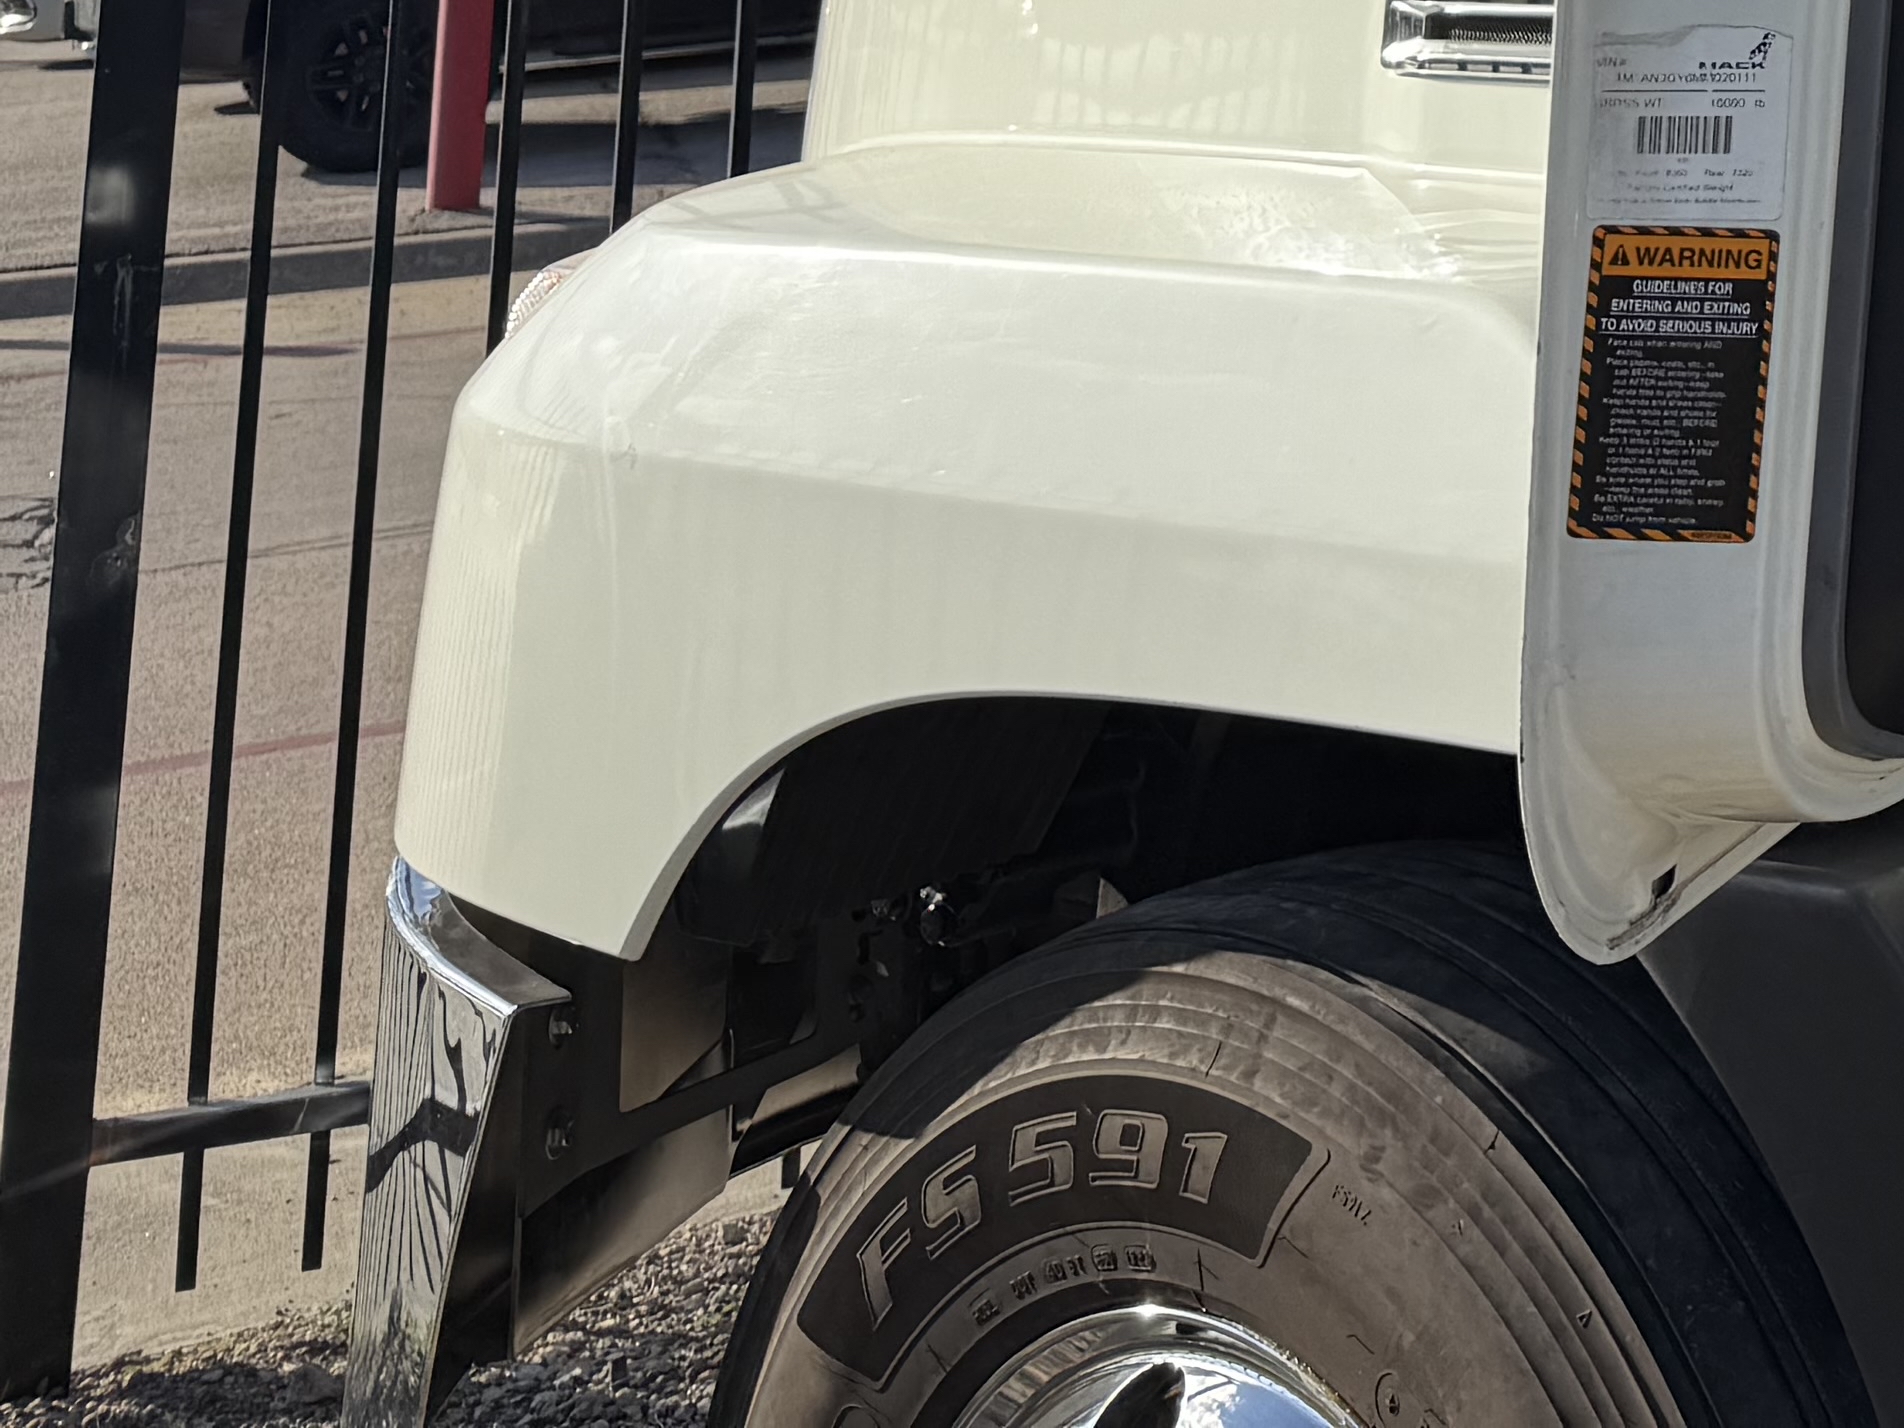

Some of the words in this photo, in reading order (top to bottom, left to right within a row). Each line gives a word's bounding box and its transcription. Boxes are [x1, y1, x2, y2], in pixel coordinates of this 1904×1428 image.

[1698, 60, 1765, 71] MACK
[1633, 243, 1763, 271] WARNING
[1632, 277, 1705, 295] GUIDELINES
[1707, 280, 1732, 296] FOR
[1611, 297, 1672, 312] ENTERING
[1674, 300, 1700, 314] AND
[1703, 302, 1750, 316] EXITING
[1600, 315, 1616, 330] TO
[1619, 316, 1656, 331] AVOID
[1658, 318, 1712, 334] SERIOUS
[1714, 321, 1758, 336] INJURY
